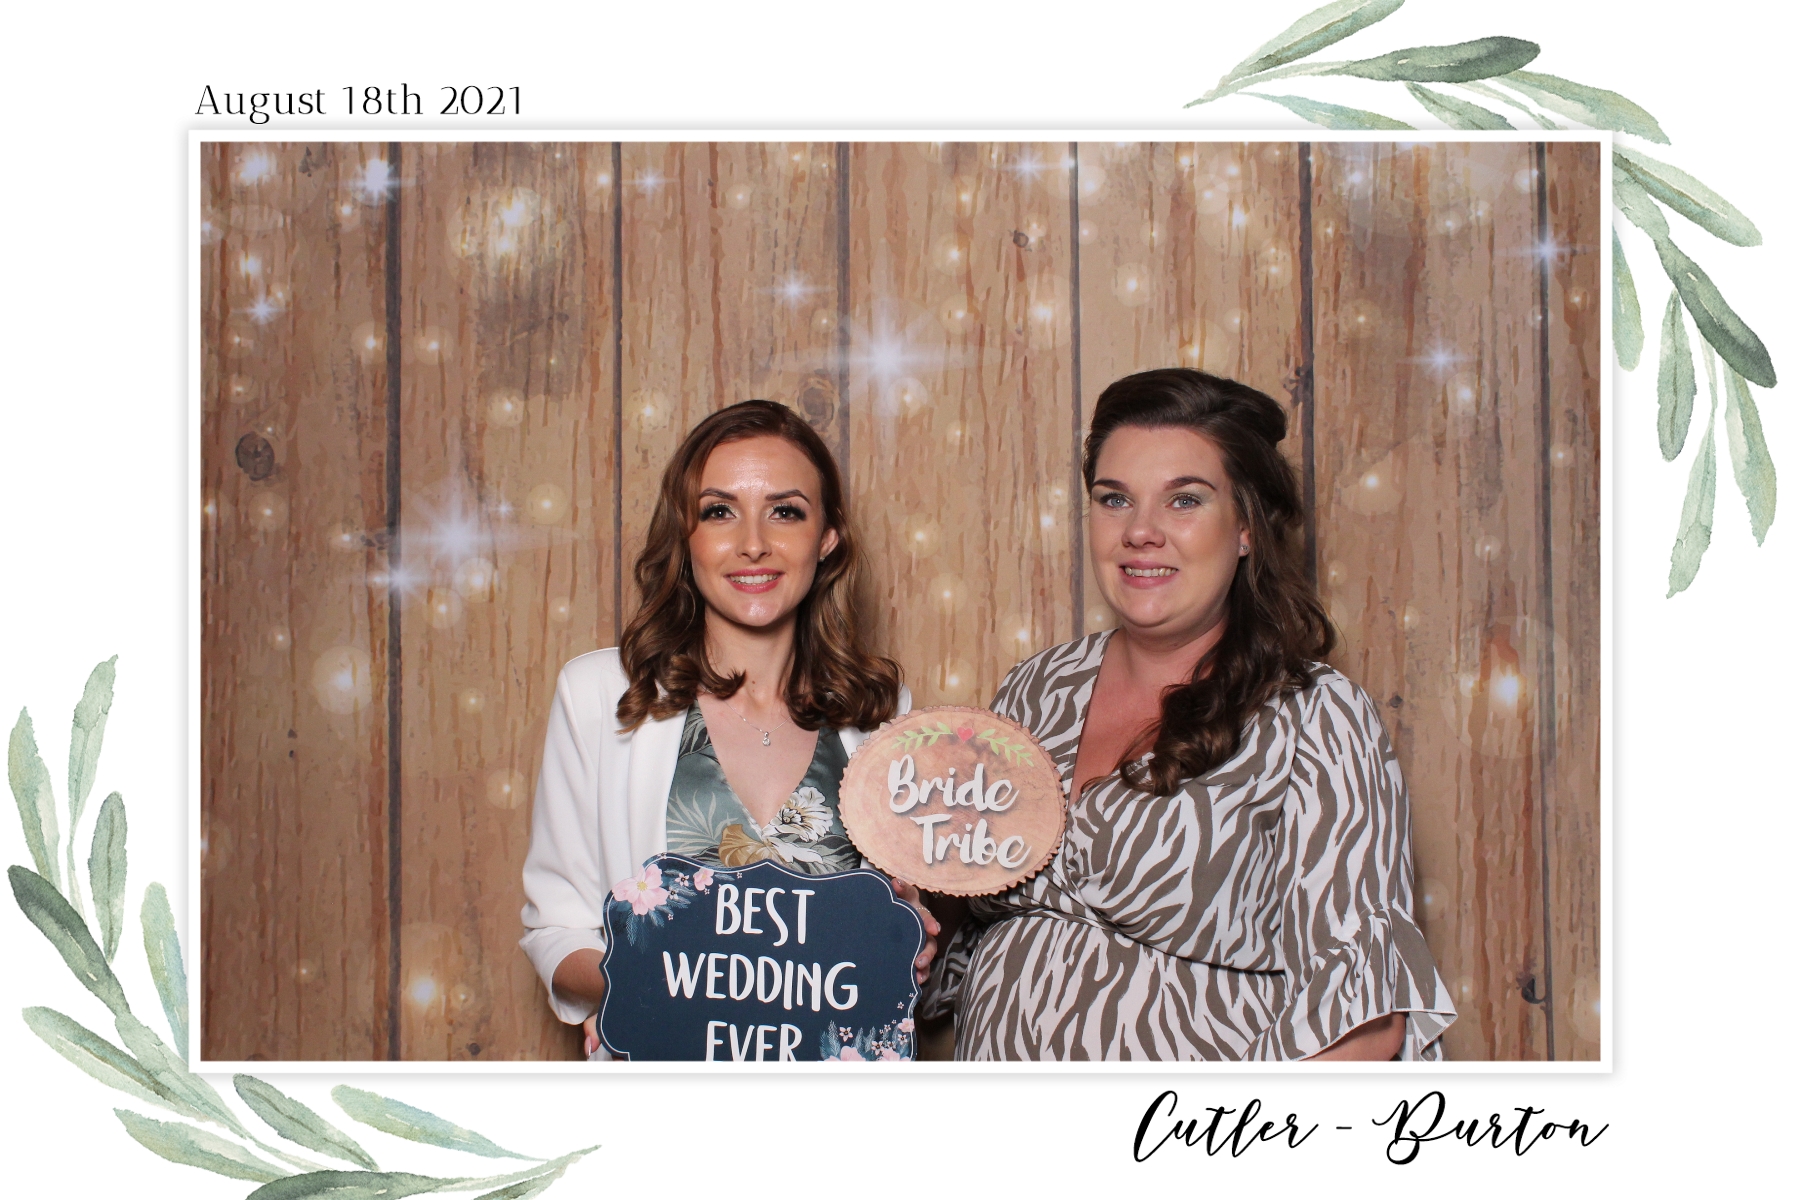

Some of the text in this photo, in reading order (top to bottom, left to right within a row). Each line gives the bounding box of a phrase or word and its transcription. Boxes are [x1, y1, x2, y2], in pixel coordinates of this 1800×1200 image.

[888, 754, 1020, 814] Bride
[910, 813, 1032, 869] Tribe
[715, 883, 816, 947] BEST
[662, 950, 859, 1012] WEDDING
[705, 1020, 803, 1062] EVER
